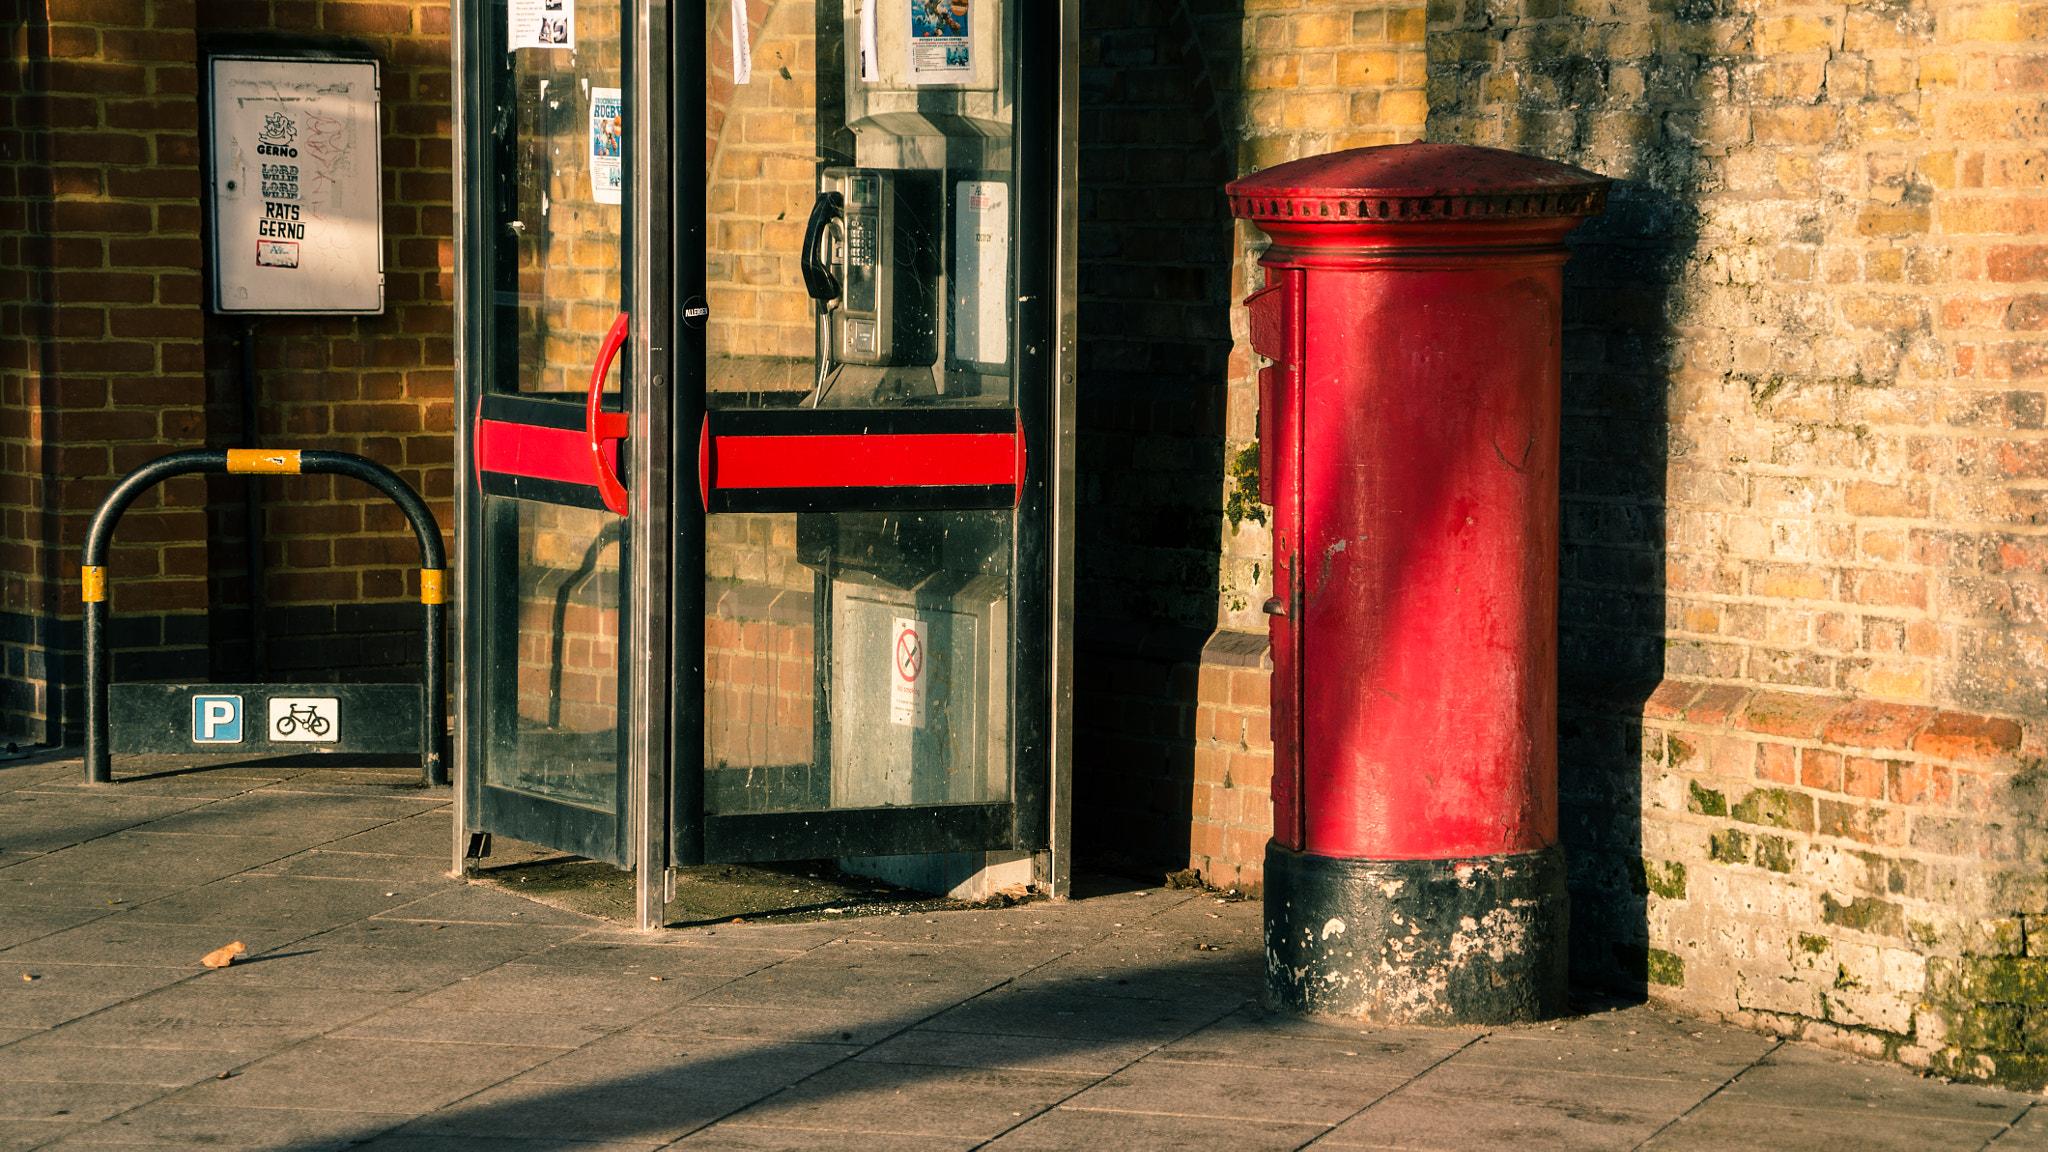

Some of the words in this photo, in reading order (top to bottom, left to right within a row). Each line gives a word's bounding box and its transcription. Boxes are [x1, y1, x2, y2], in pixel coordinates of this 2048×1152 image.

[594, 104, 622, 118] RUGBY
[257, 145, 298, 158] GERNO
[262, 164, 298, 175] LORD
[262, 181, 298, 192] LORD
[266, 202, 299, 220] RATS
[259, 220, 304, 240] GERNO
[204, 701, 235, 738] P
